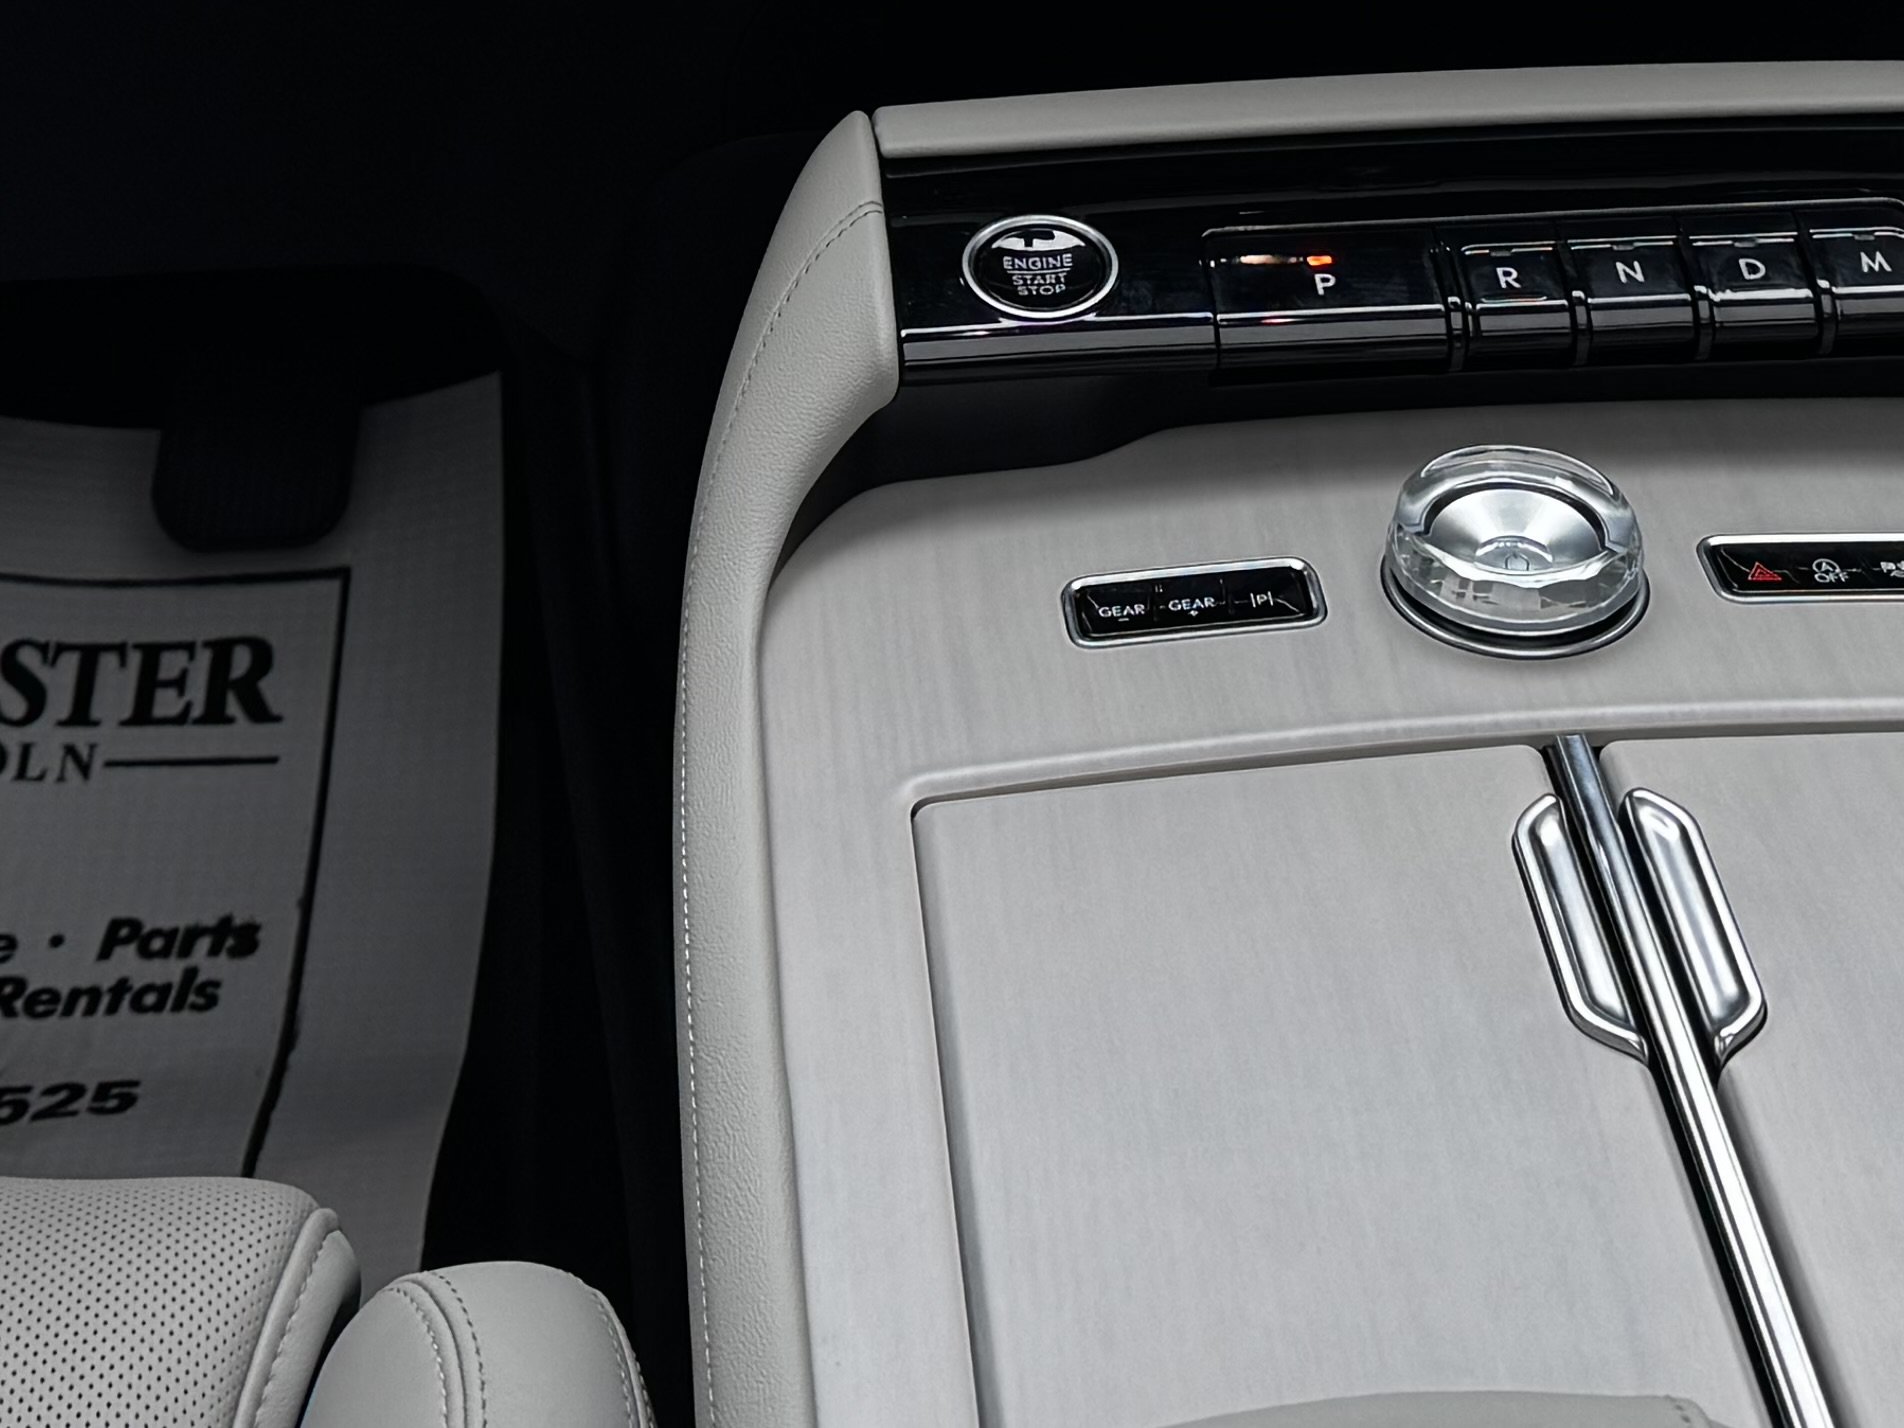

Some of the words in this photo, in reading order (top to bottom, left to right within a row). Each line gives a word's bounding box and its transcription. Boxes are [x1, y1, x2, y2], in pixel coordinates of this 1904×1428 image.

[1003, 253, 1073, 270] ENGINE
[1615, 260, 1645, 283] N
[1738, 257, 1766, 280] D
[1860, 250, 1892, 273] M
[1012, 272, 1068, 286] START
[1313, 272, 1337, 296] P
[1496, 266, 1521, 289] R
[1017, 283, 1066, 296] STOP
[1813, 571, 1850, 584] OFF
[1098, 603, 1146, 619] GEAR
[1167, 596, 1216, 612] GEAR
[97, 912, 261, 962] Parts
